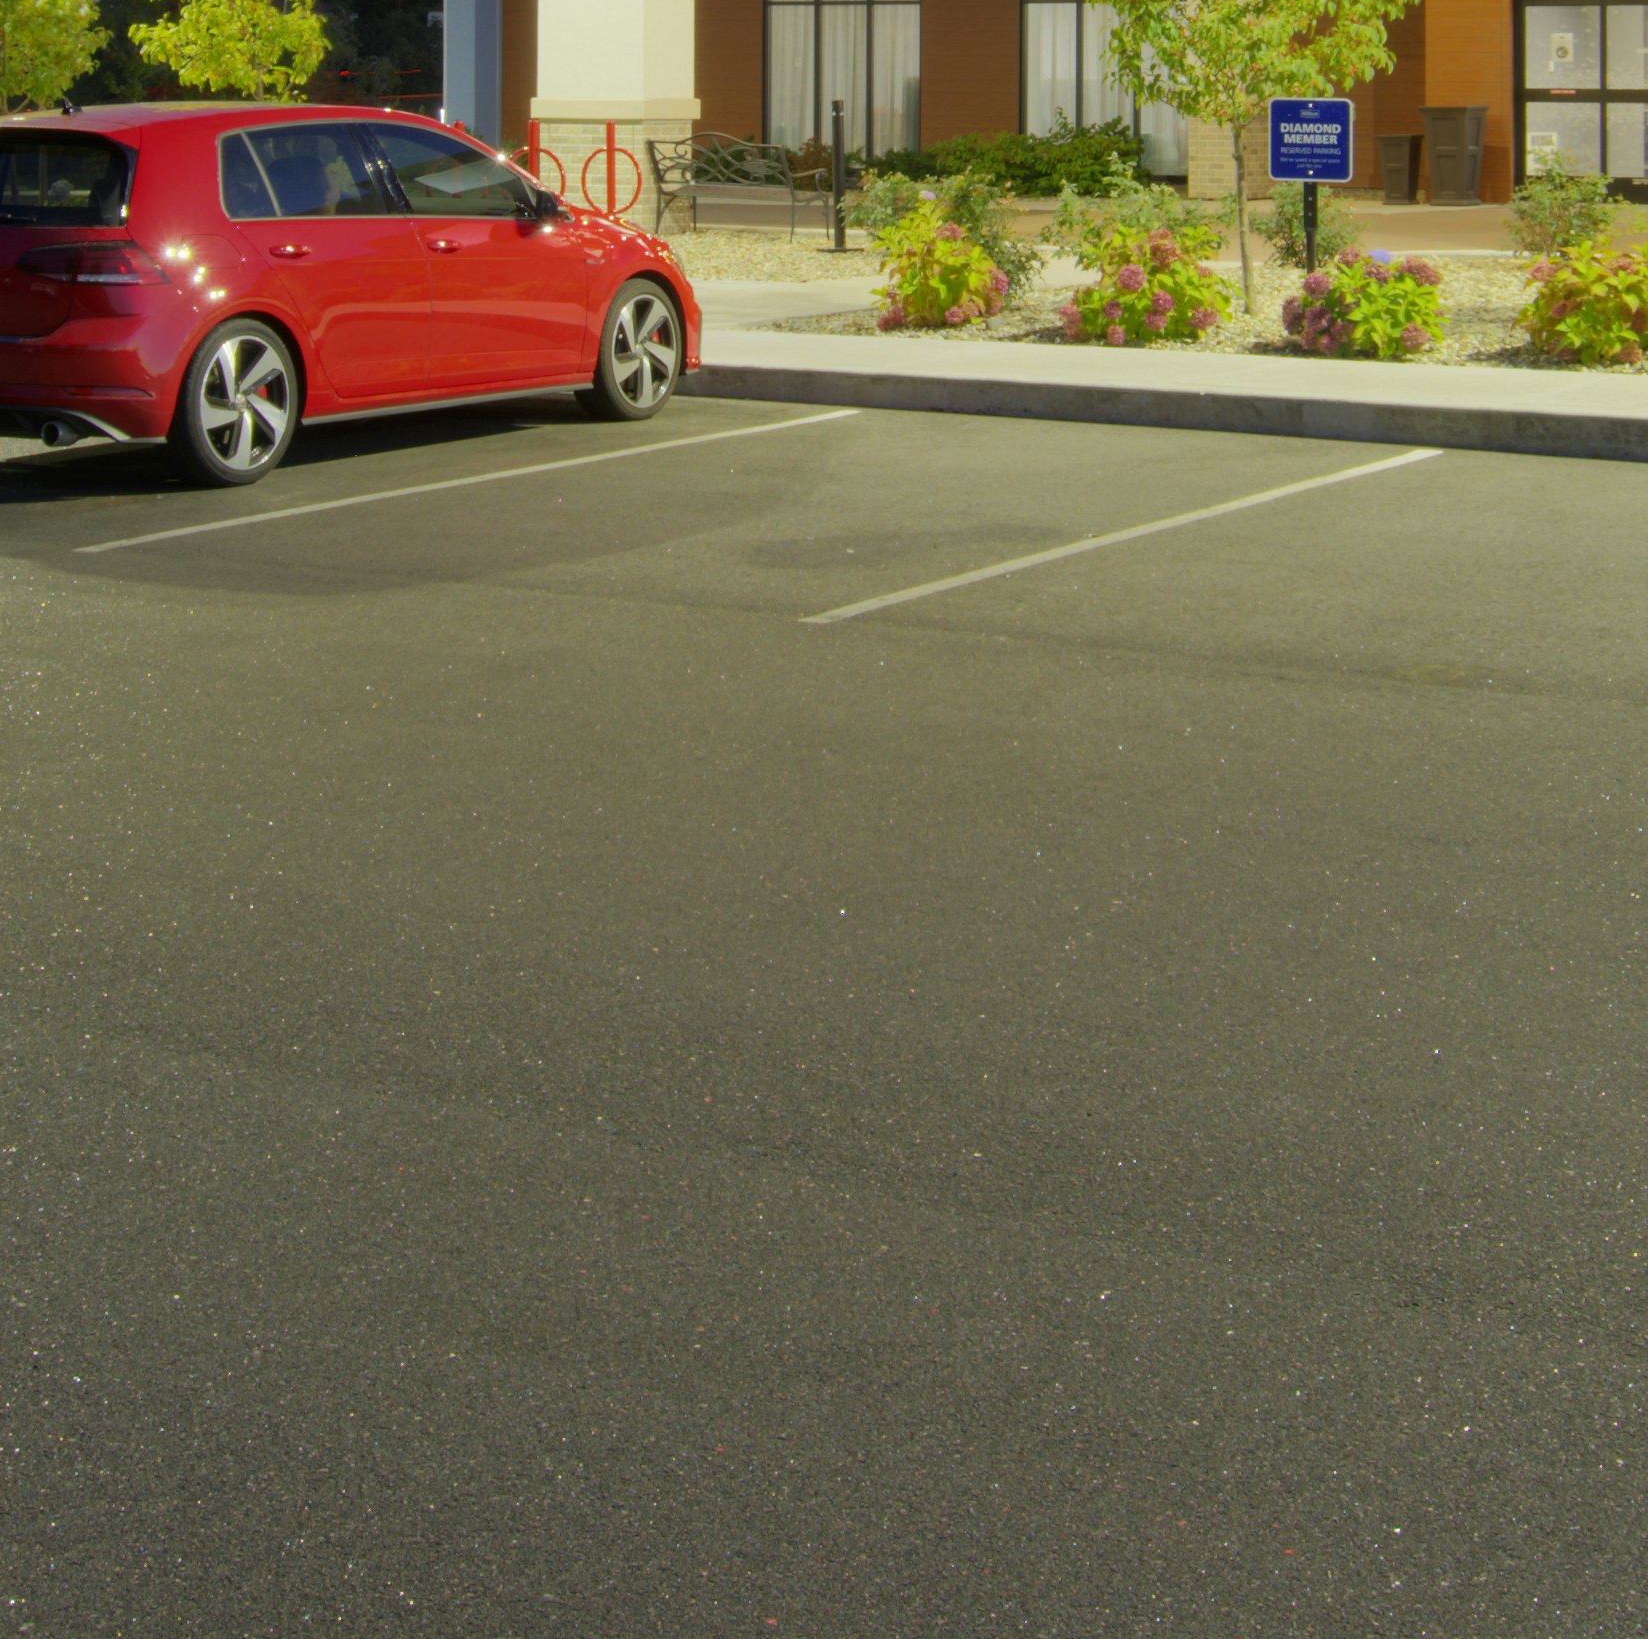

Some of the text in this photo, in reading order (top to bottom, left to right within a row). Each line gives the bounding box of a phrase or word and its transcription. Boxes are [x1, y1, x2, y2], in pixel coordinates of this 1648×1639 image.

[1280, 123, 1342, 133] DIAMOND
[1284, 134, 1338, 144] MEMBER
[1313, 147, 1342, 155] PARKING
